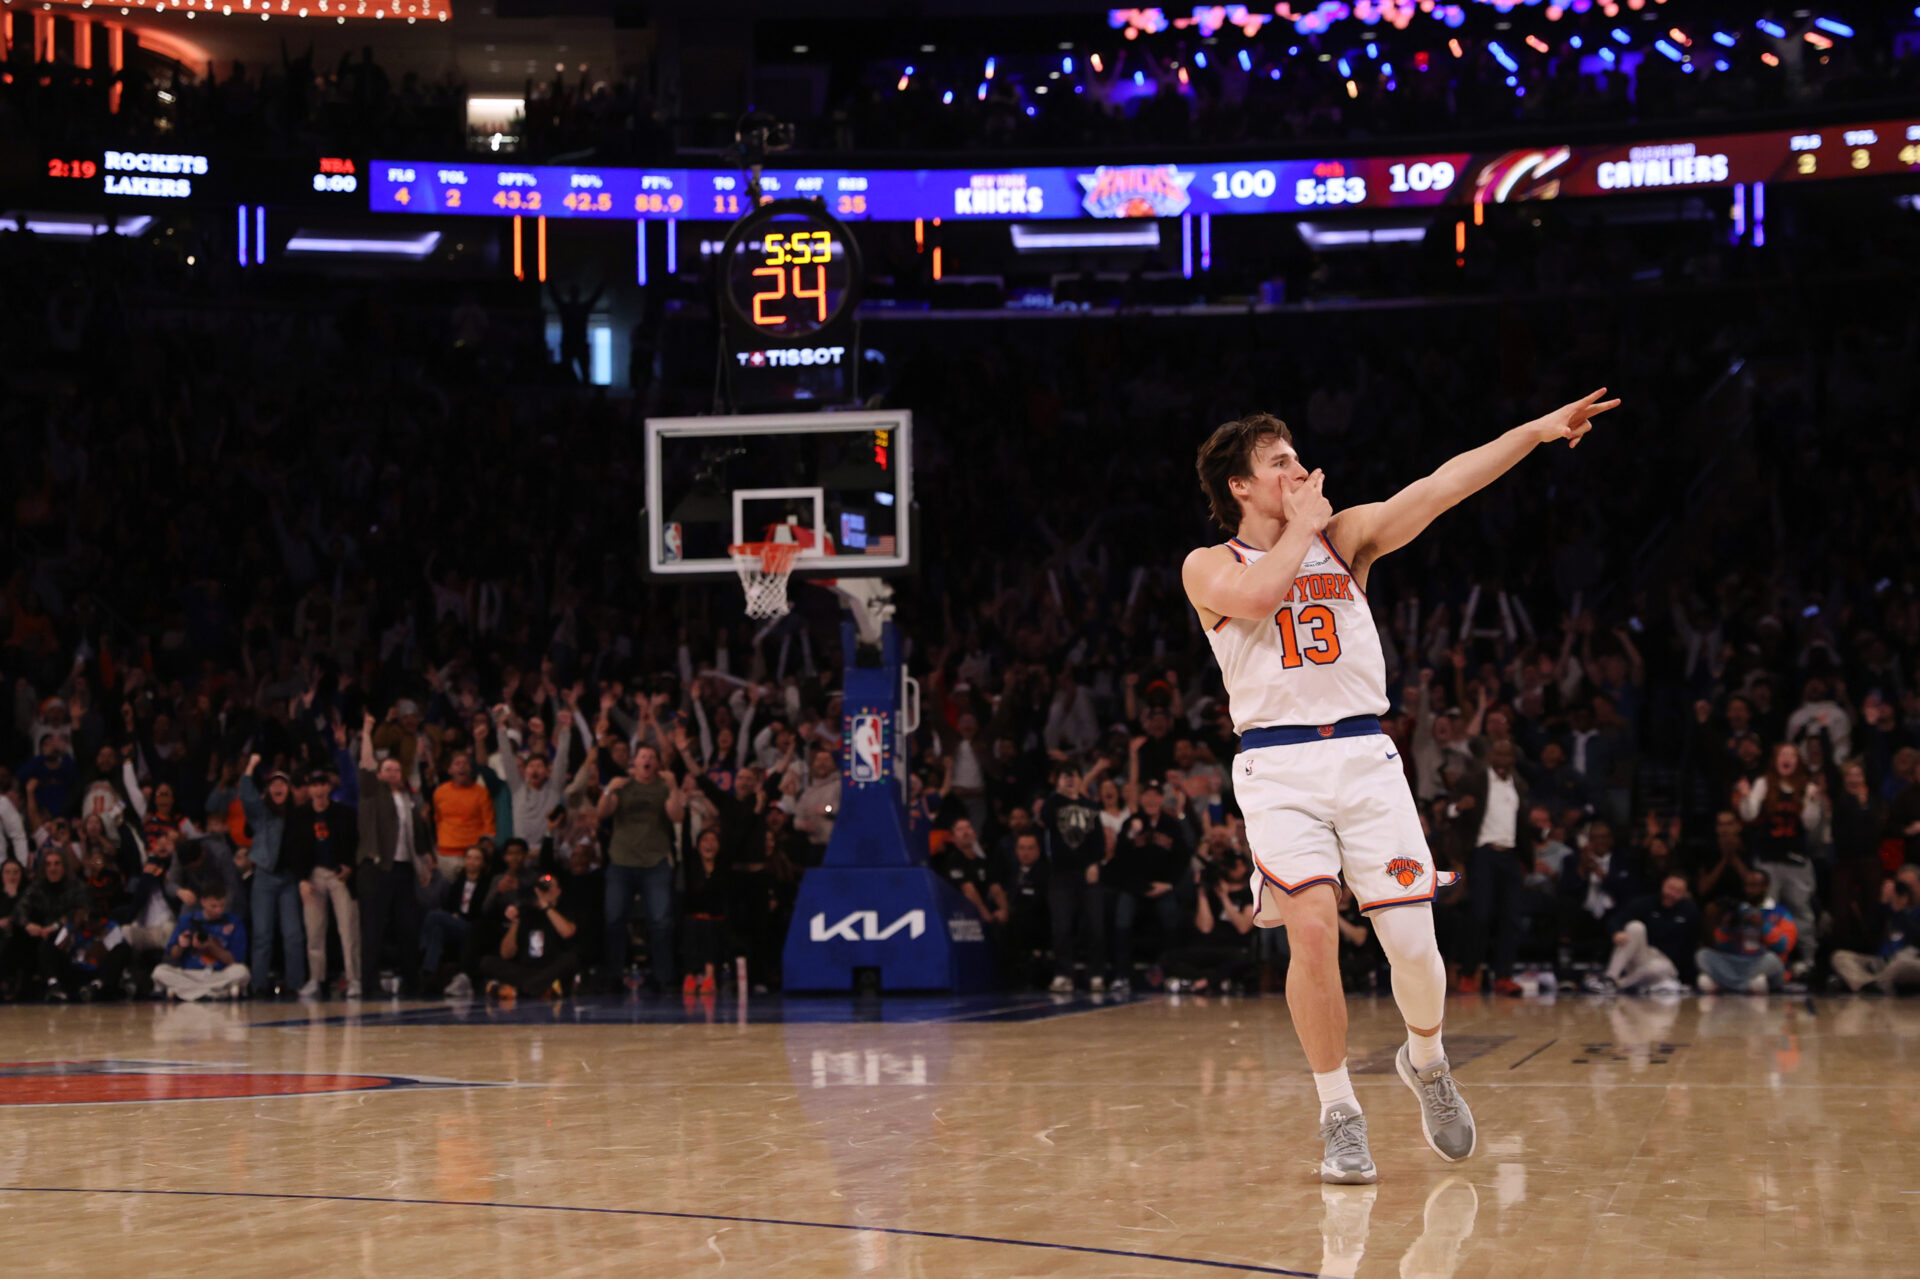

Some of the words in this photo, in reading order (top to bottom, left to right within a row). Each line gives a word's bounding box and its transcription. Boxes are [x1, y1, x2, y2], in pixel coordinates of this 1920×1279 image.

[47, 158, 97, 179] 2:19
[104, 151, 209, 175] ROCKETS
[319, 157, 356, 174] NBA
[1597, 154, 1729, 189] CAVALIERS
[1851, 149, 1871, 169] 3
[104, 174, 192, 198] LAKERS
[1211, 169, 1276, 200] 100
[1295, 176, 1367, 205] 5:53
[1388, 161, 1456, 192] 109
[394, 187, 411, 205] 4
[445, 188, 461, 207] 2
[492, 190, 542, 210] 43.2
[563, 192, 613, 212] 42.5
[714, 195, 739, 214] 11
[954, 186, 1043, 214] KNICKS
[764, 231, 832, 266] 5:53
[752, 264, 827, 325] 24
[765, 346, 845, 367] TISSOT
[1274, 604, 1342, 670] 13
[1386, 858, 1424, 873] KNICKS
[810, 909, 926, 942] KIA
